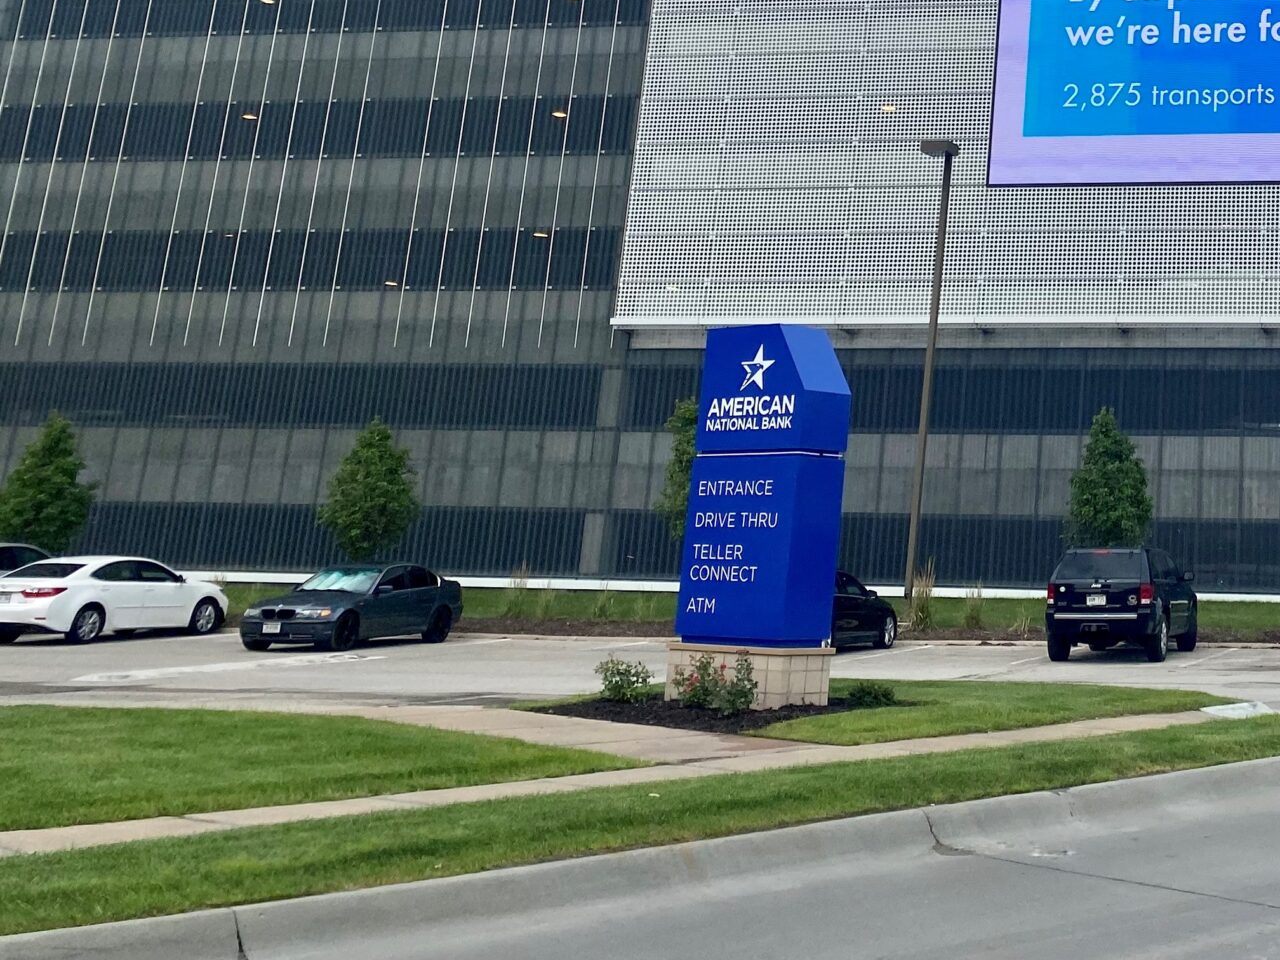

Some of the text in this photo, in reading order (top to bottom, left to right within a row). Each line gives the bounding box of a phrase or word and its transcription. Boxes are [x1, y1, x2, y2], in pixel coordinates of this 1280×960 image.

[1065, 15, 1160, 47] we're
[1172, 10, 1246, 44] here
[1062, 82, 1142, 112] 2,875
[1152, 83, 1275, 113] transports
[708, 394, 795, 418] AMERICAN
[705, 416, 793, 432] NATIONAL BANK
[698, 479, 774, 496] ENTRANCE
[695, 512, 778, 528] DRIVE THRU
[693, 543, 743, 560] TELLER
[689, 564, 758, 582] CONNECT
[686, 597, 716, 614] ATM
